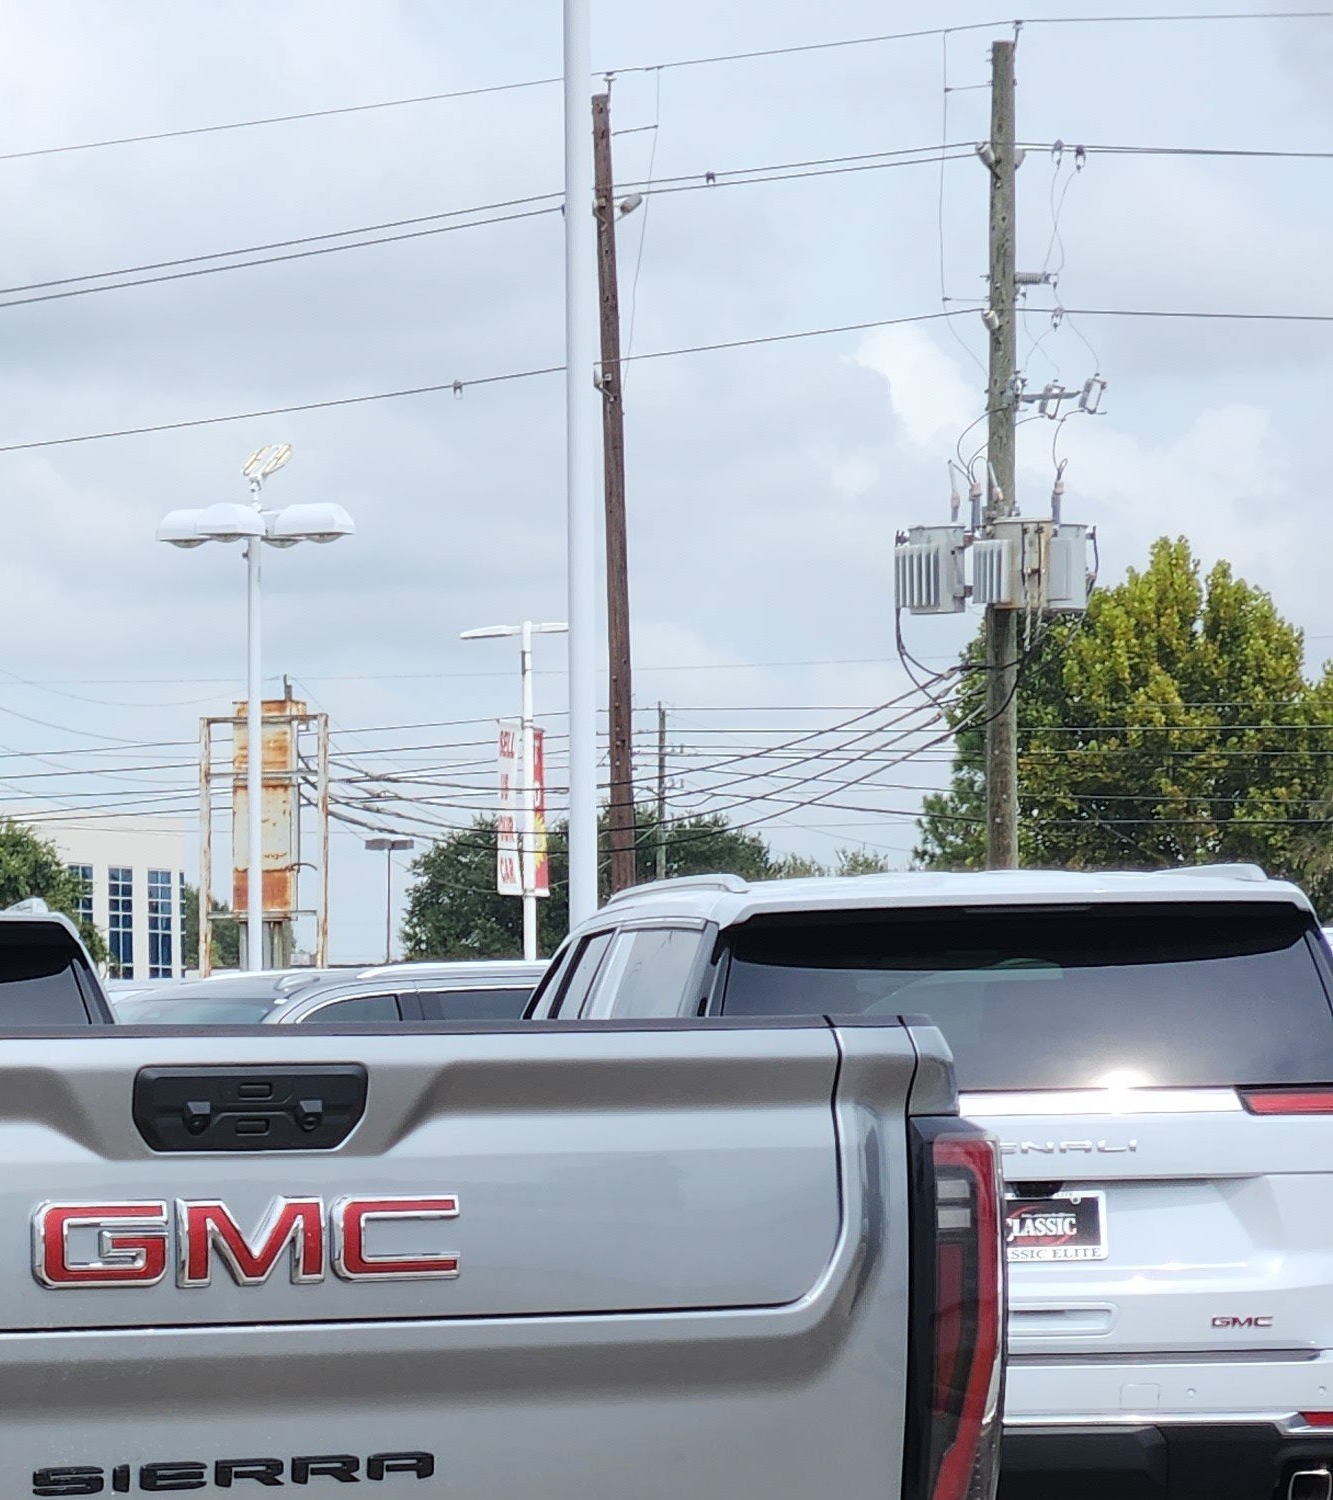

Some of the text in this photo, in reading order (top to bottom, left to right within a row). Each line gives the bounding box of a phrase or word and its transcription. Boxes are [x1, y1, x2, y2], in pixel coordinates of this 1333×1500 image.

[31, 1193, 461, 1290] GMC
[1008, 1247, 1102, 1260] SSIC ELITE
[1212, 1316, 1273, 1328] GMC
[32, 1451, 435, 1497] SIERRA
